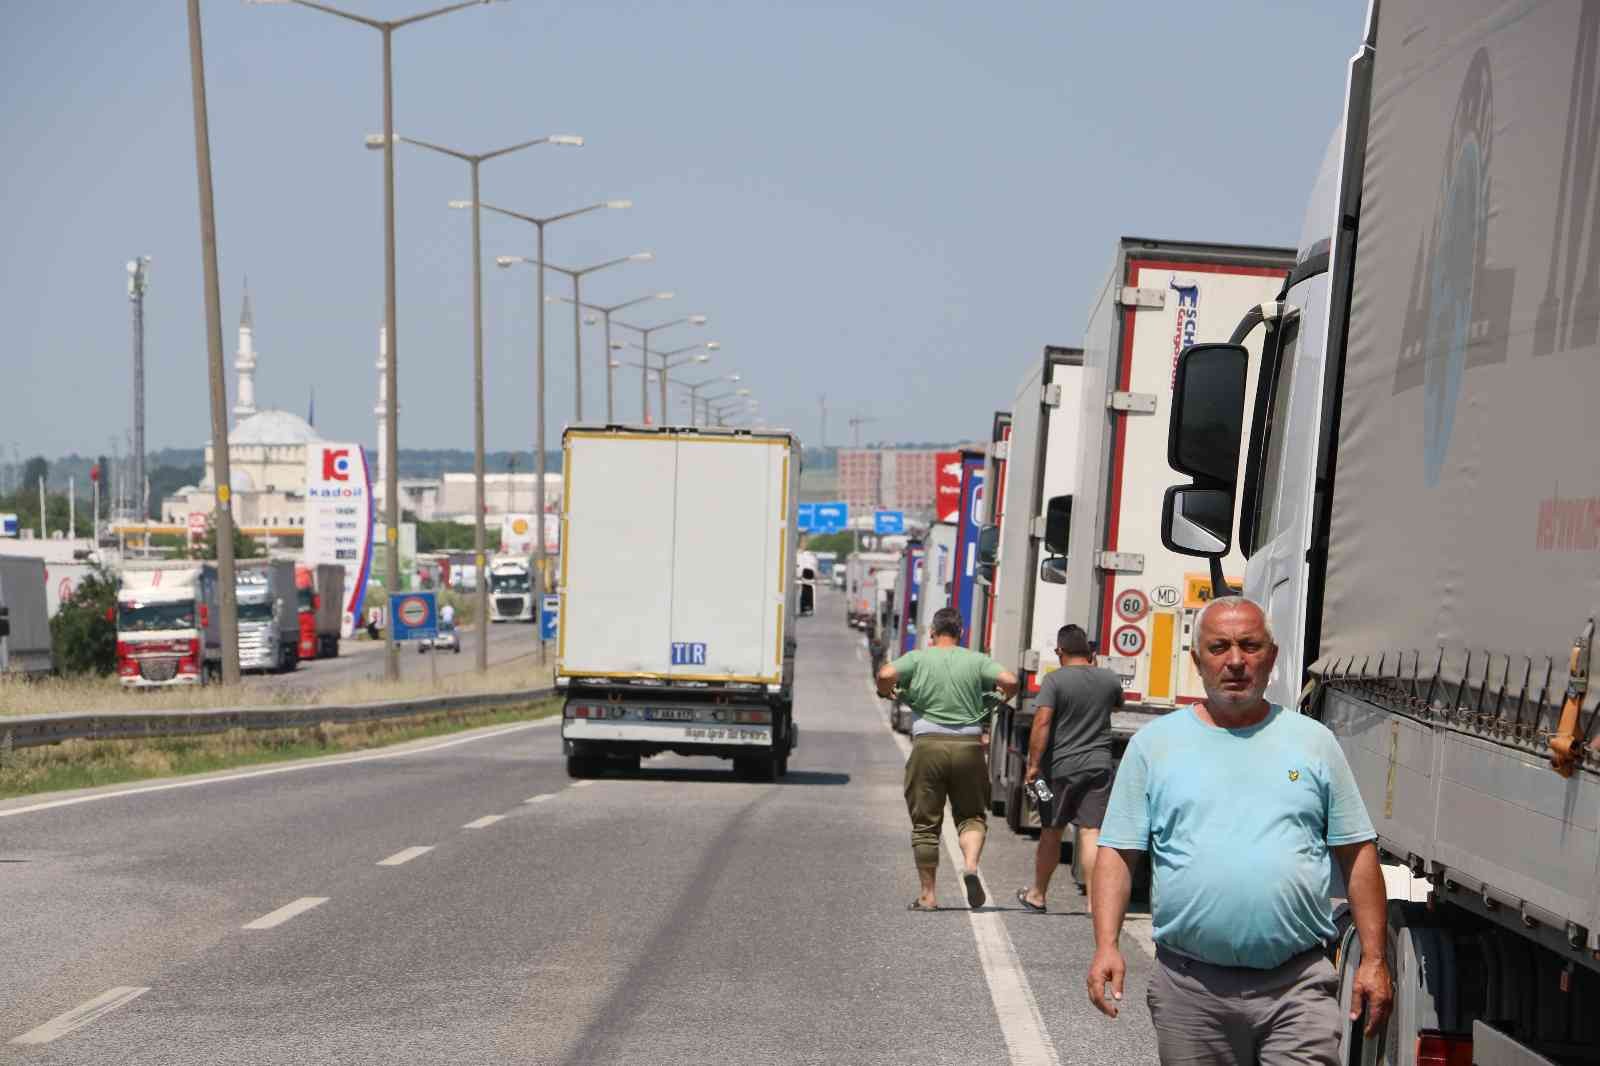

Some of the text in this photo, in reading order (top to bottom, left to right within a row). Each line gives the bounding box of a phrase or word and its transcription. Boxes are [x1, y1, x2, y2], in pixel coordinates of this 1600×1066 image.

[1157, 589, 1176, 604] MD
[1123, 599, 1140, 612] 60
[1121, 633, 1137, 647] 70
[674, 643, 705, 664] TIR
